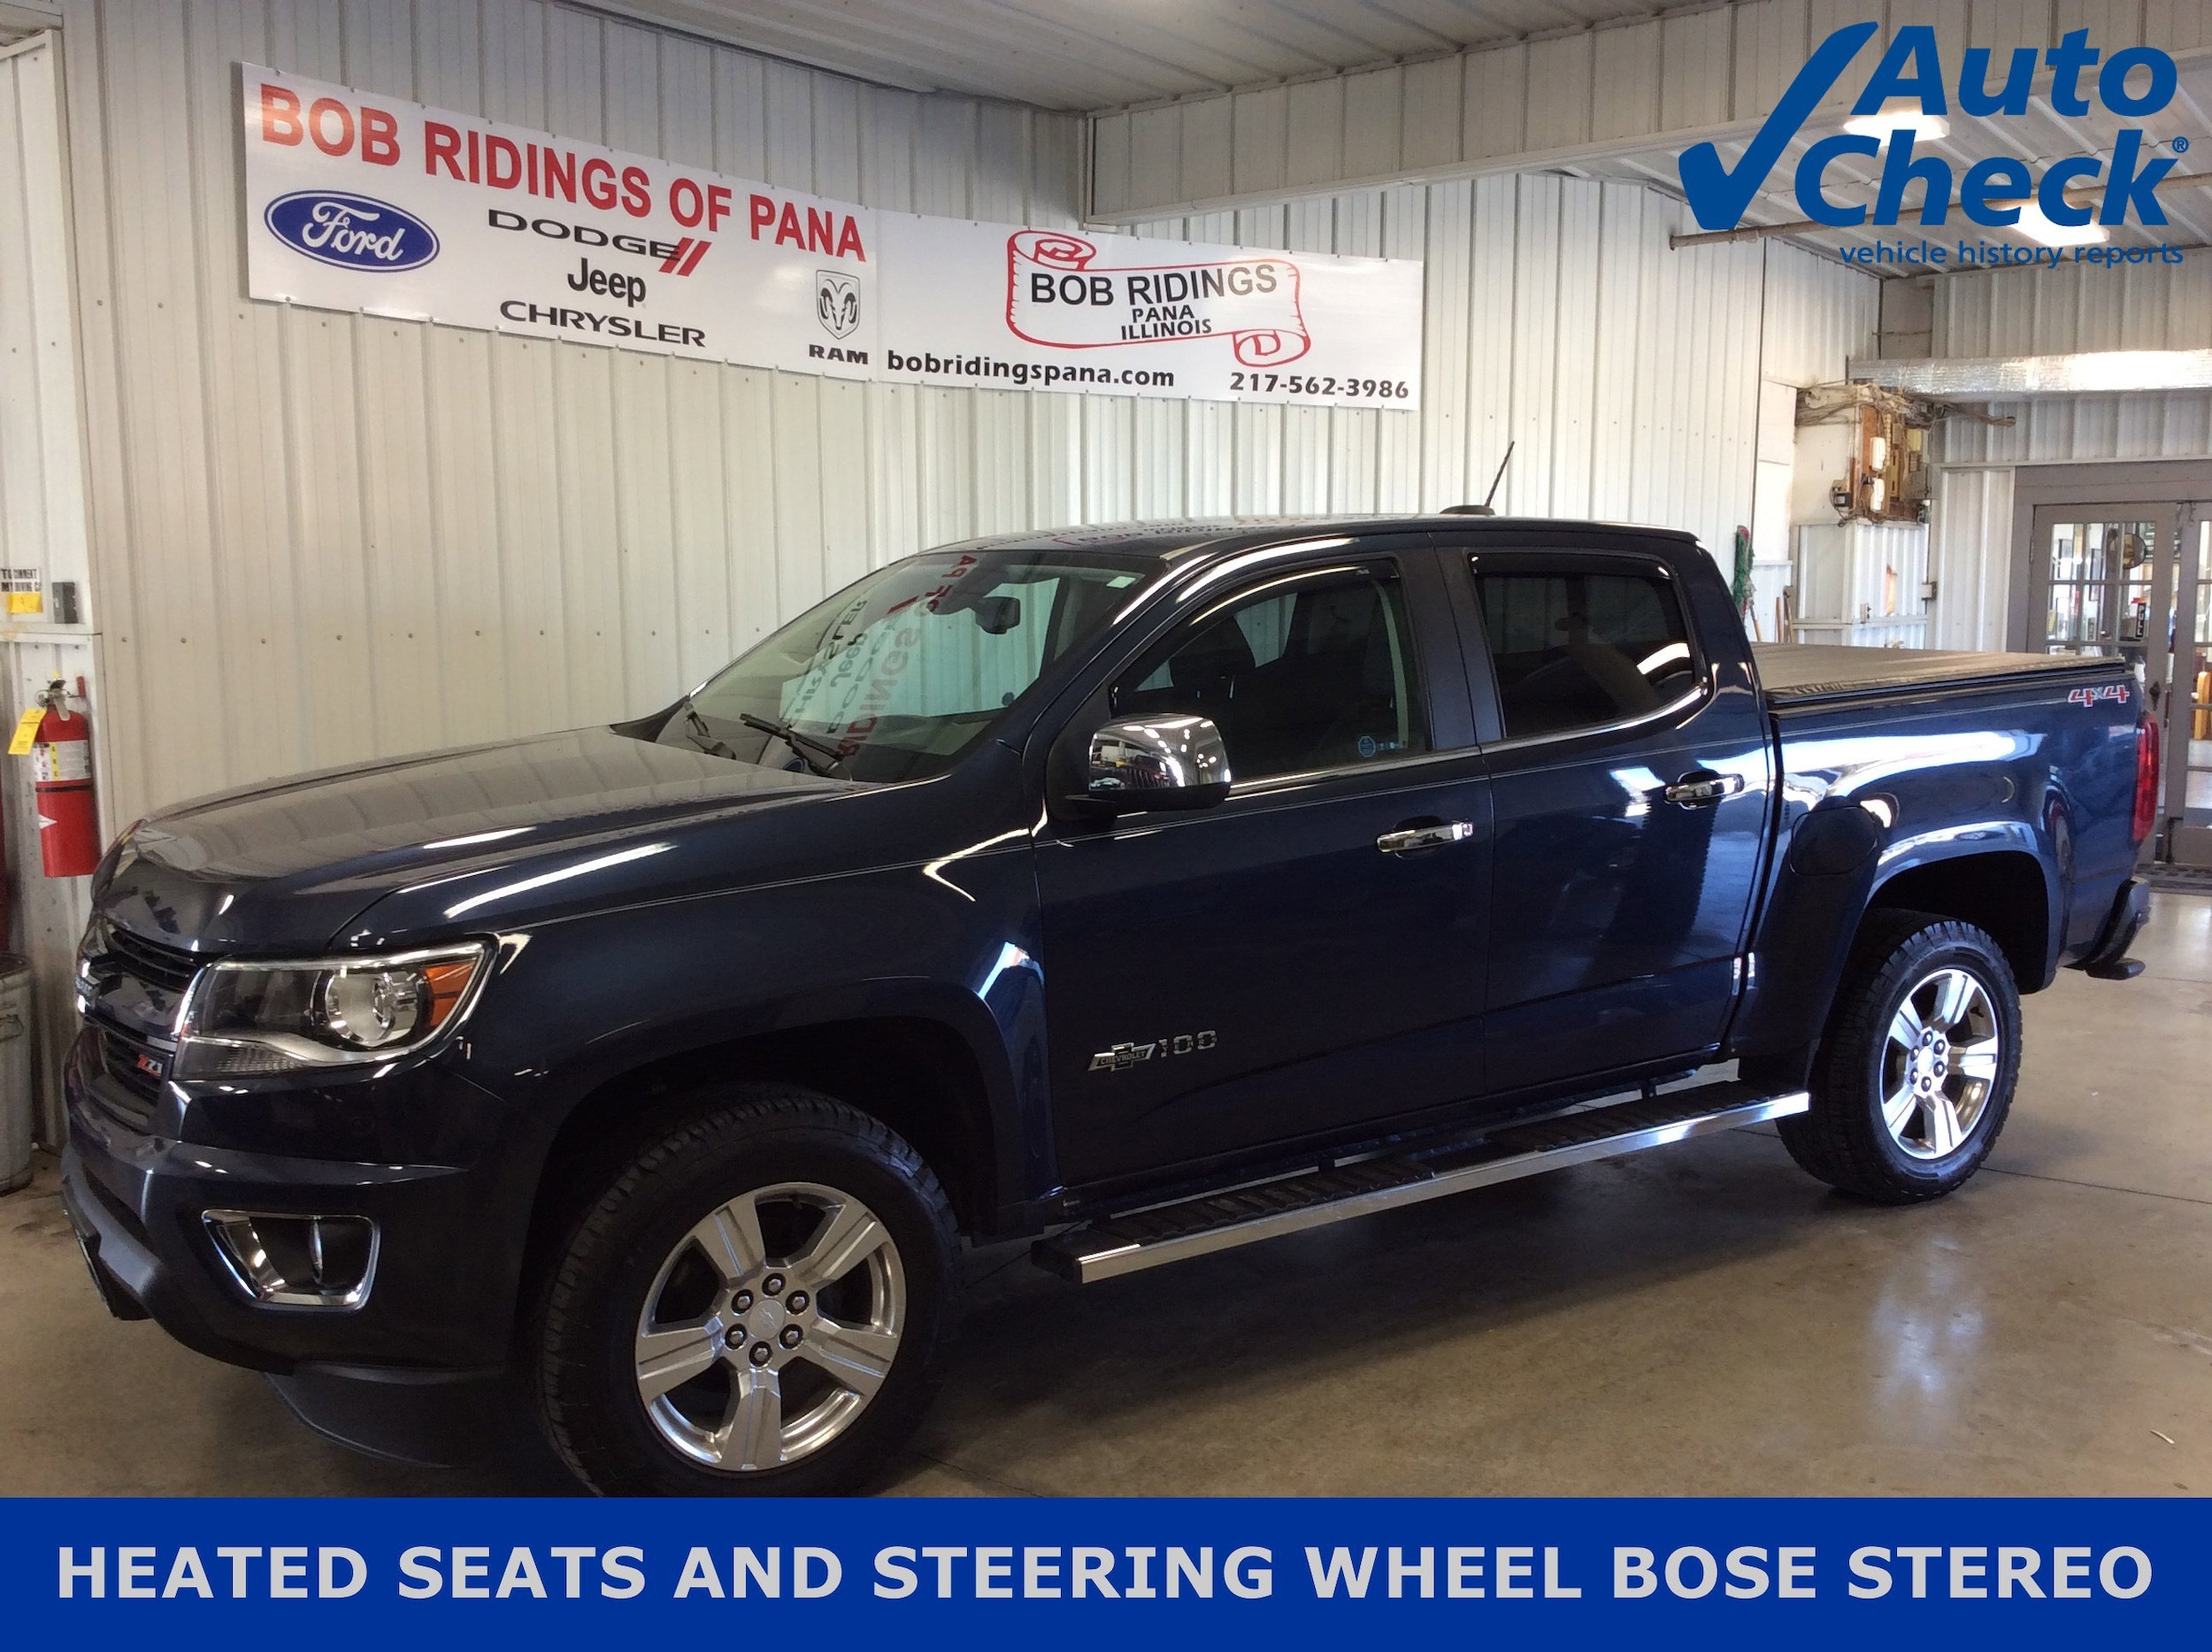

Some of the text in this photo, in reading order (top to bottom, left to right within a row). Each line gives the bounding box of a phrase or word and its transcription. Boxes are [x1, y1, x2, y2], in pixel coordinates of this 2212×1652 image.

[262, 84, 866, 262] BOB RIDINGS OF PANA
[302, 201, 406, 261] Ford
[488, 209, 681, 262] DODGE
[567, 257, 647, 308] Jeep
[1031, 264, 1277, 306] BOB RIDINGS
[500, 300, 706, 348] CHRYSLER
[1121, 319, 1212, 341] ILLINOIS
[1132, 304, 1195, 323] PANA
[809, 343, 869, 365] RAM
[887, 350, 1175, 387] bobridingspana.com
[1230, 373, 1409, 400] 217-562-3986
[2137, 604, 2146, 636] PULL
[1100, 1030, 1218, 1065] CHEVROLET 100
